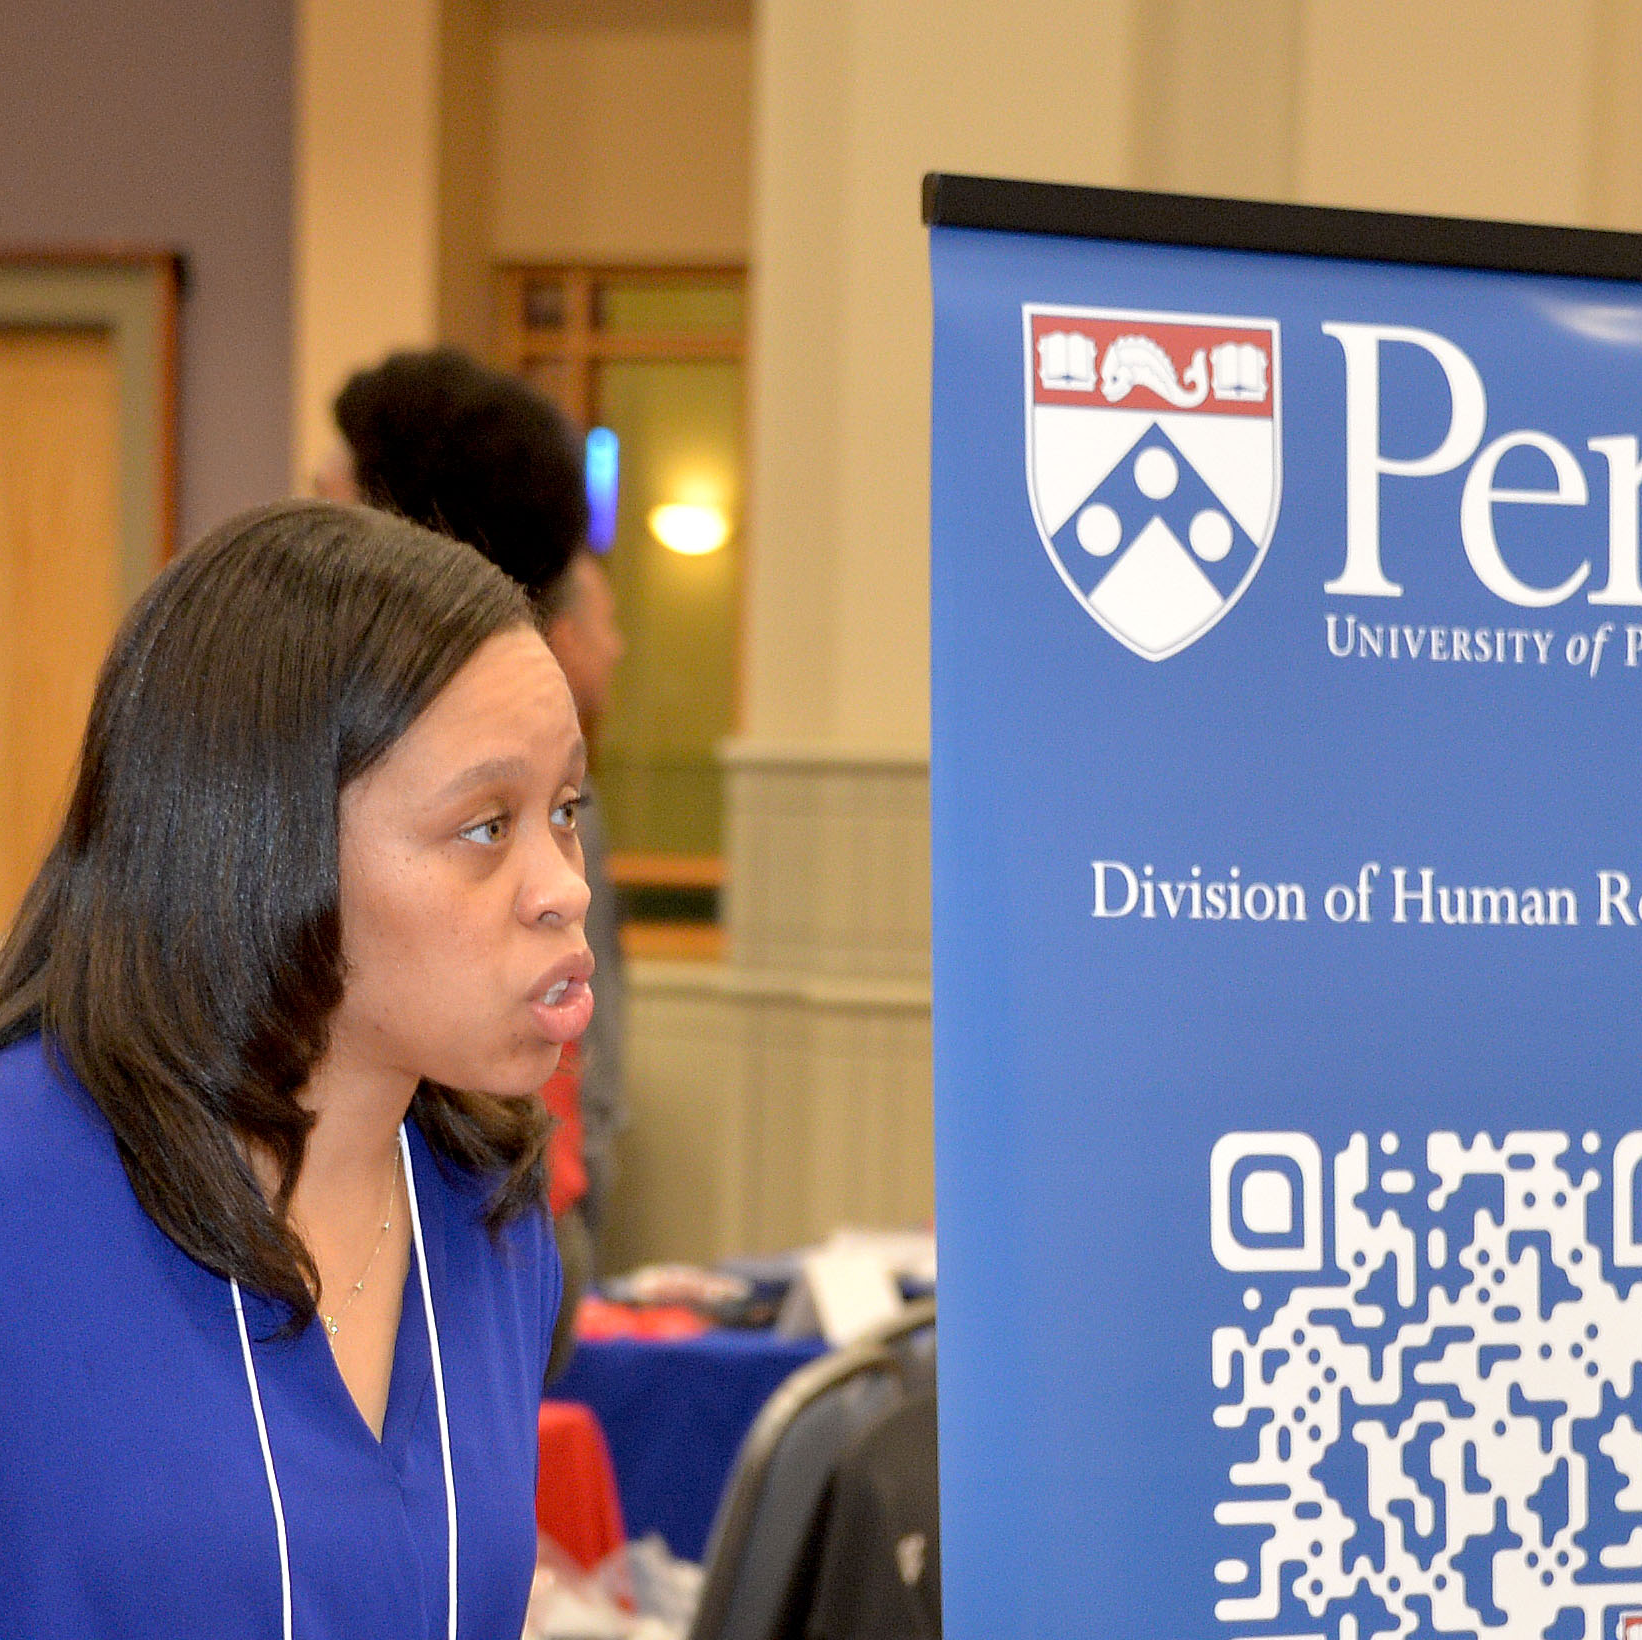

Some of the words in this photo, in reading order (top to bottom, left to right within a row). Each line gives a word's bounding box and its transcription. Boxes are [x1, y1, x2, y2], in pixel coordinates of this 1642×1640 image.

[1325, 613, 1554, 666] UNIVERSITY
[1565, 621, 1614, 678] of
[1090, 860, 1308, 923] Division
[1323, 861, 1381, 923] of
[1391, 866, 1578, 926] Human
